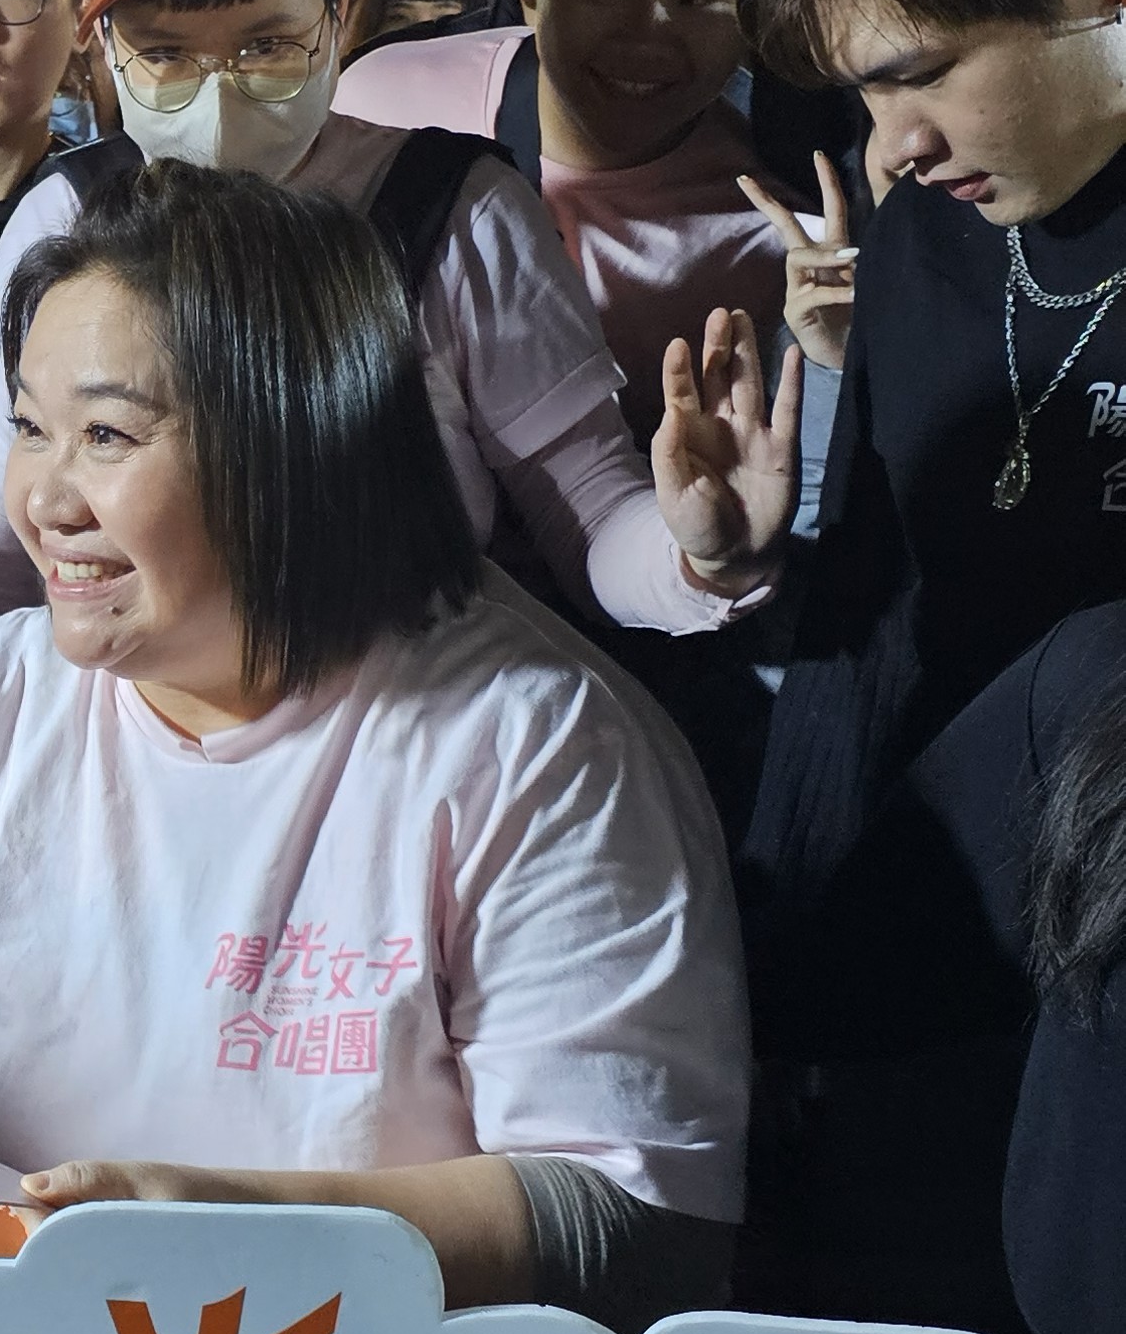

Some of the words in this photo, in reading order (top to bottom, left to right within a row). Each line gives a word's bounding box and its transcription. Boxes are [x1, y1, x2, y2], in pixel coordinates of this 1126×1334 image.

[205, 921, 418, 1000] 陽光女子
[216, 1010, 378, 1075] 合唱團
